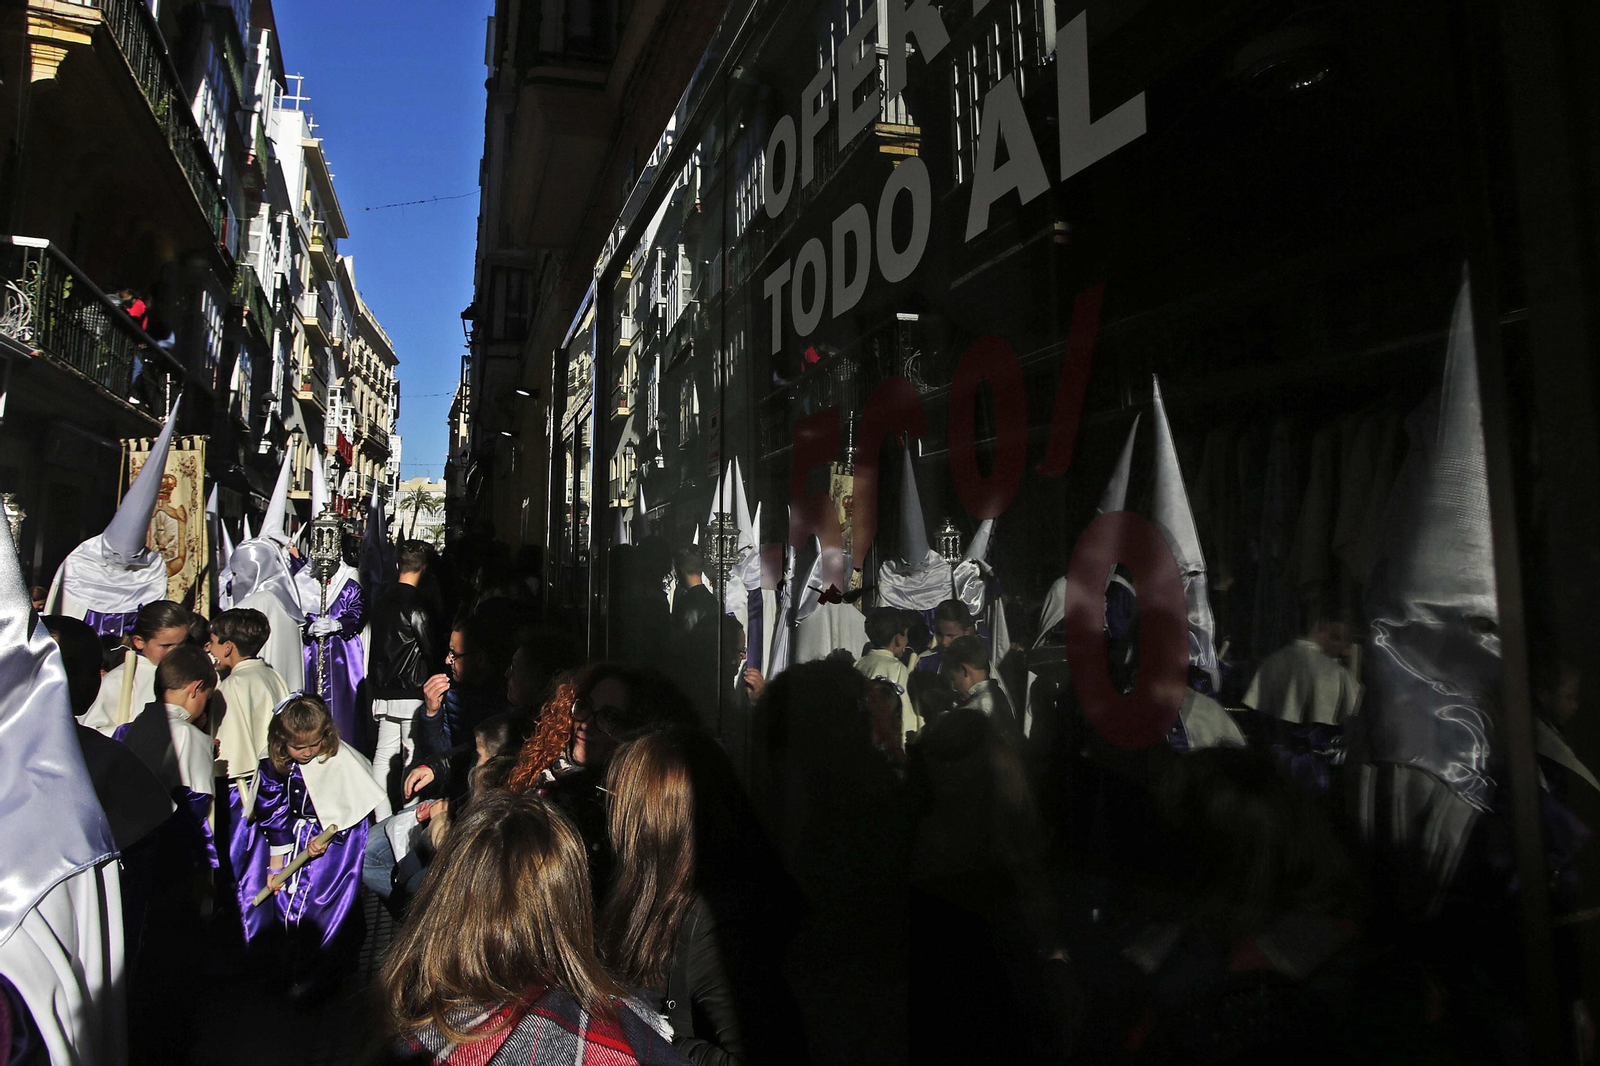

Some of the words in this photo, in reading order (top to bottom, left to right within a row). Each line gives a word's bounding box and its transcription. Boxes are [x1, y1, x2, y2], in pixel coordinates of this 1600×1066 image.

[764, 157, 931, 355] TODO
[965, 9, 1147, 243] AL
[765, 0, 990, 218] OFER
